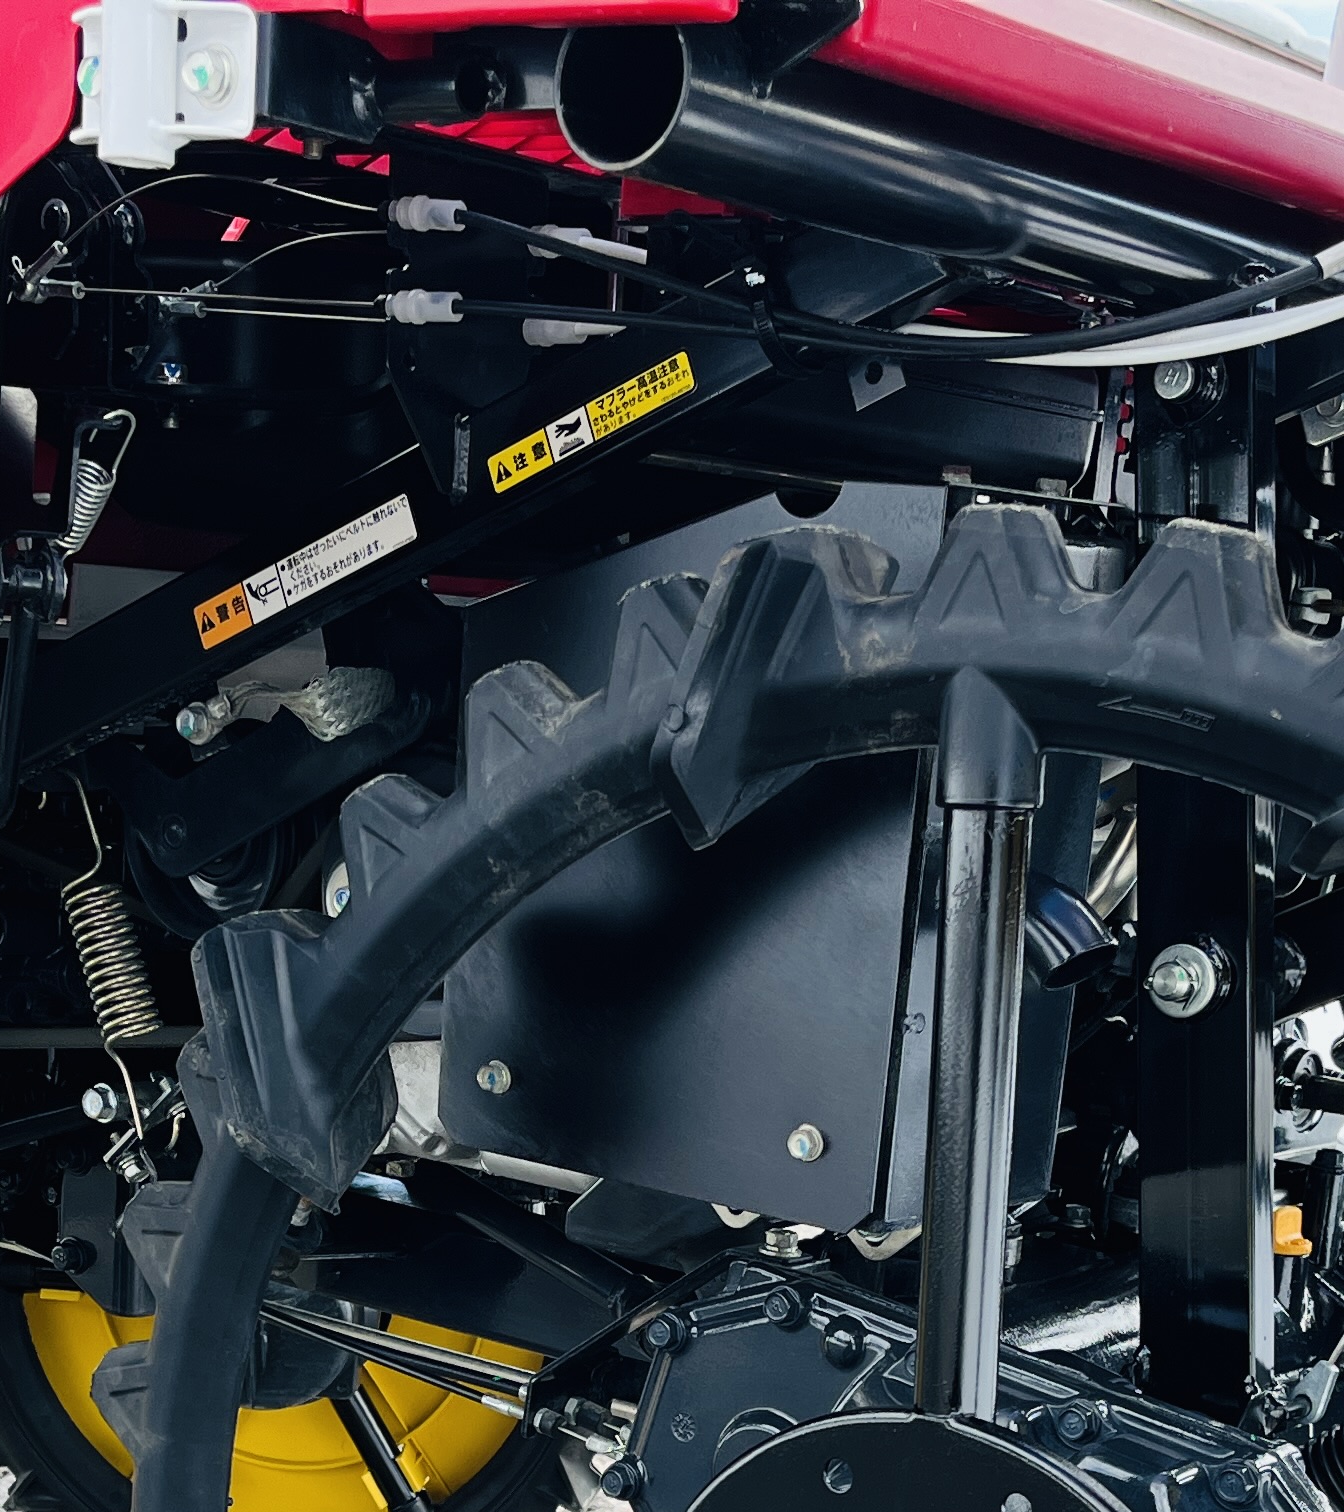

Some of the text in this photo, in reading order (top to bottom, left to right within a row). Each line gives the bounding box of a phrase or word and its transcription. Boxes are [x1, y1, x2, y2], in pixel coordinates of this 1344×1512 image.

[592, 369, 690, 427] さわるとやけどをするおそれ
[595, 358, 679, 410] マフラー高温注意
[513, 441, 547, 472] 注意
